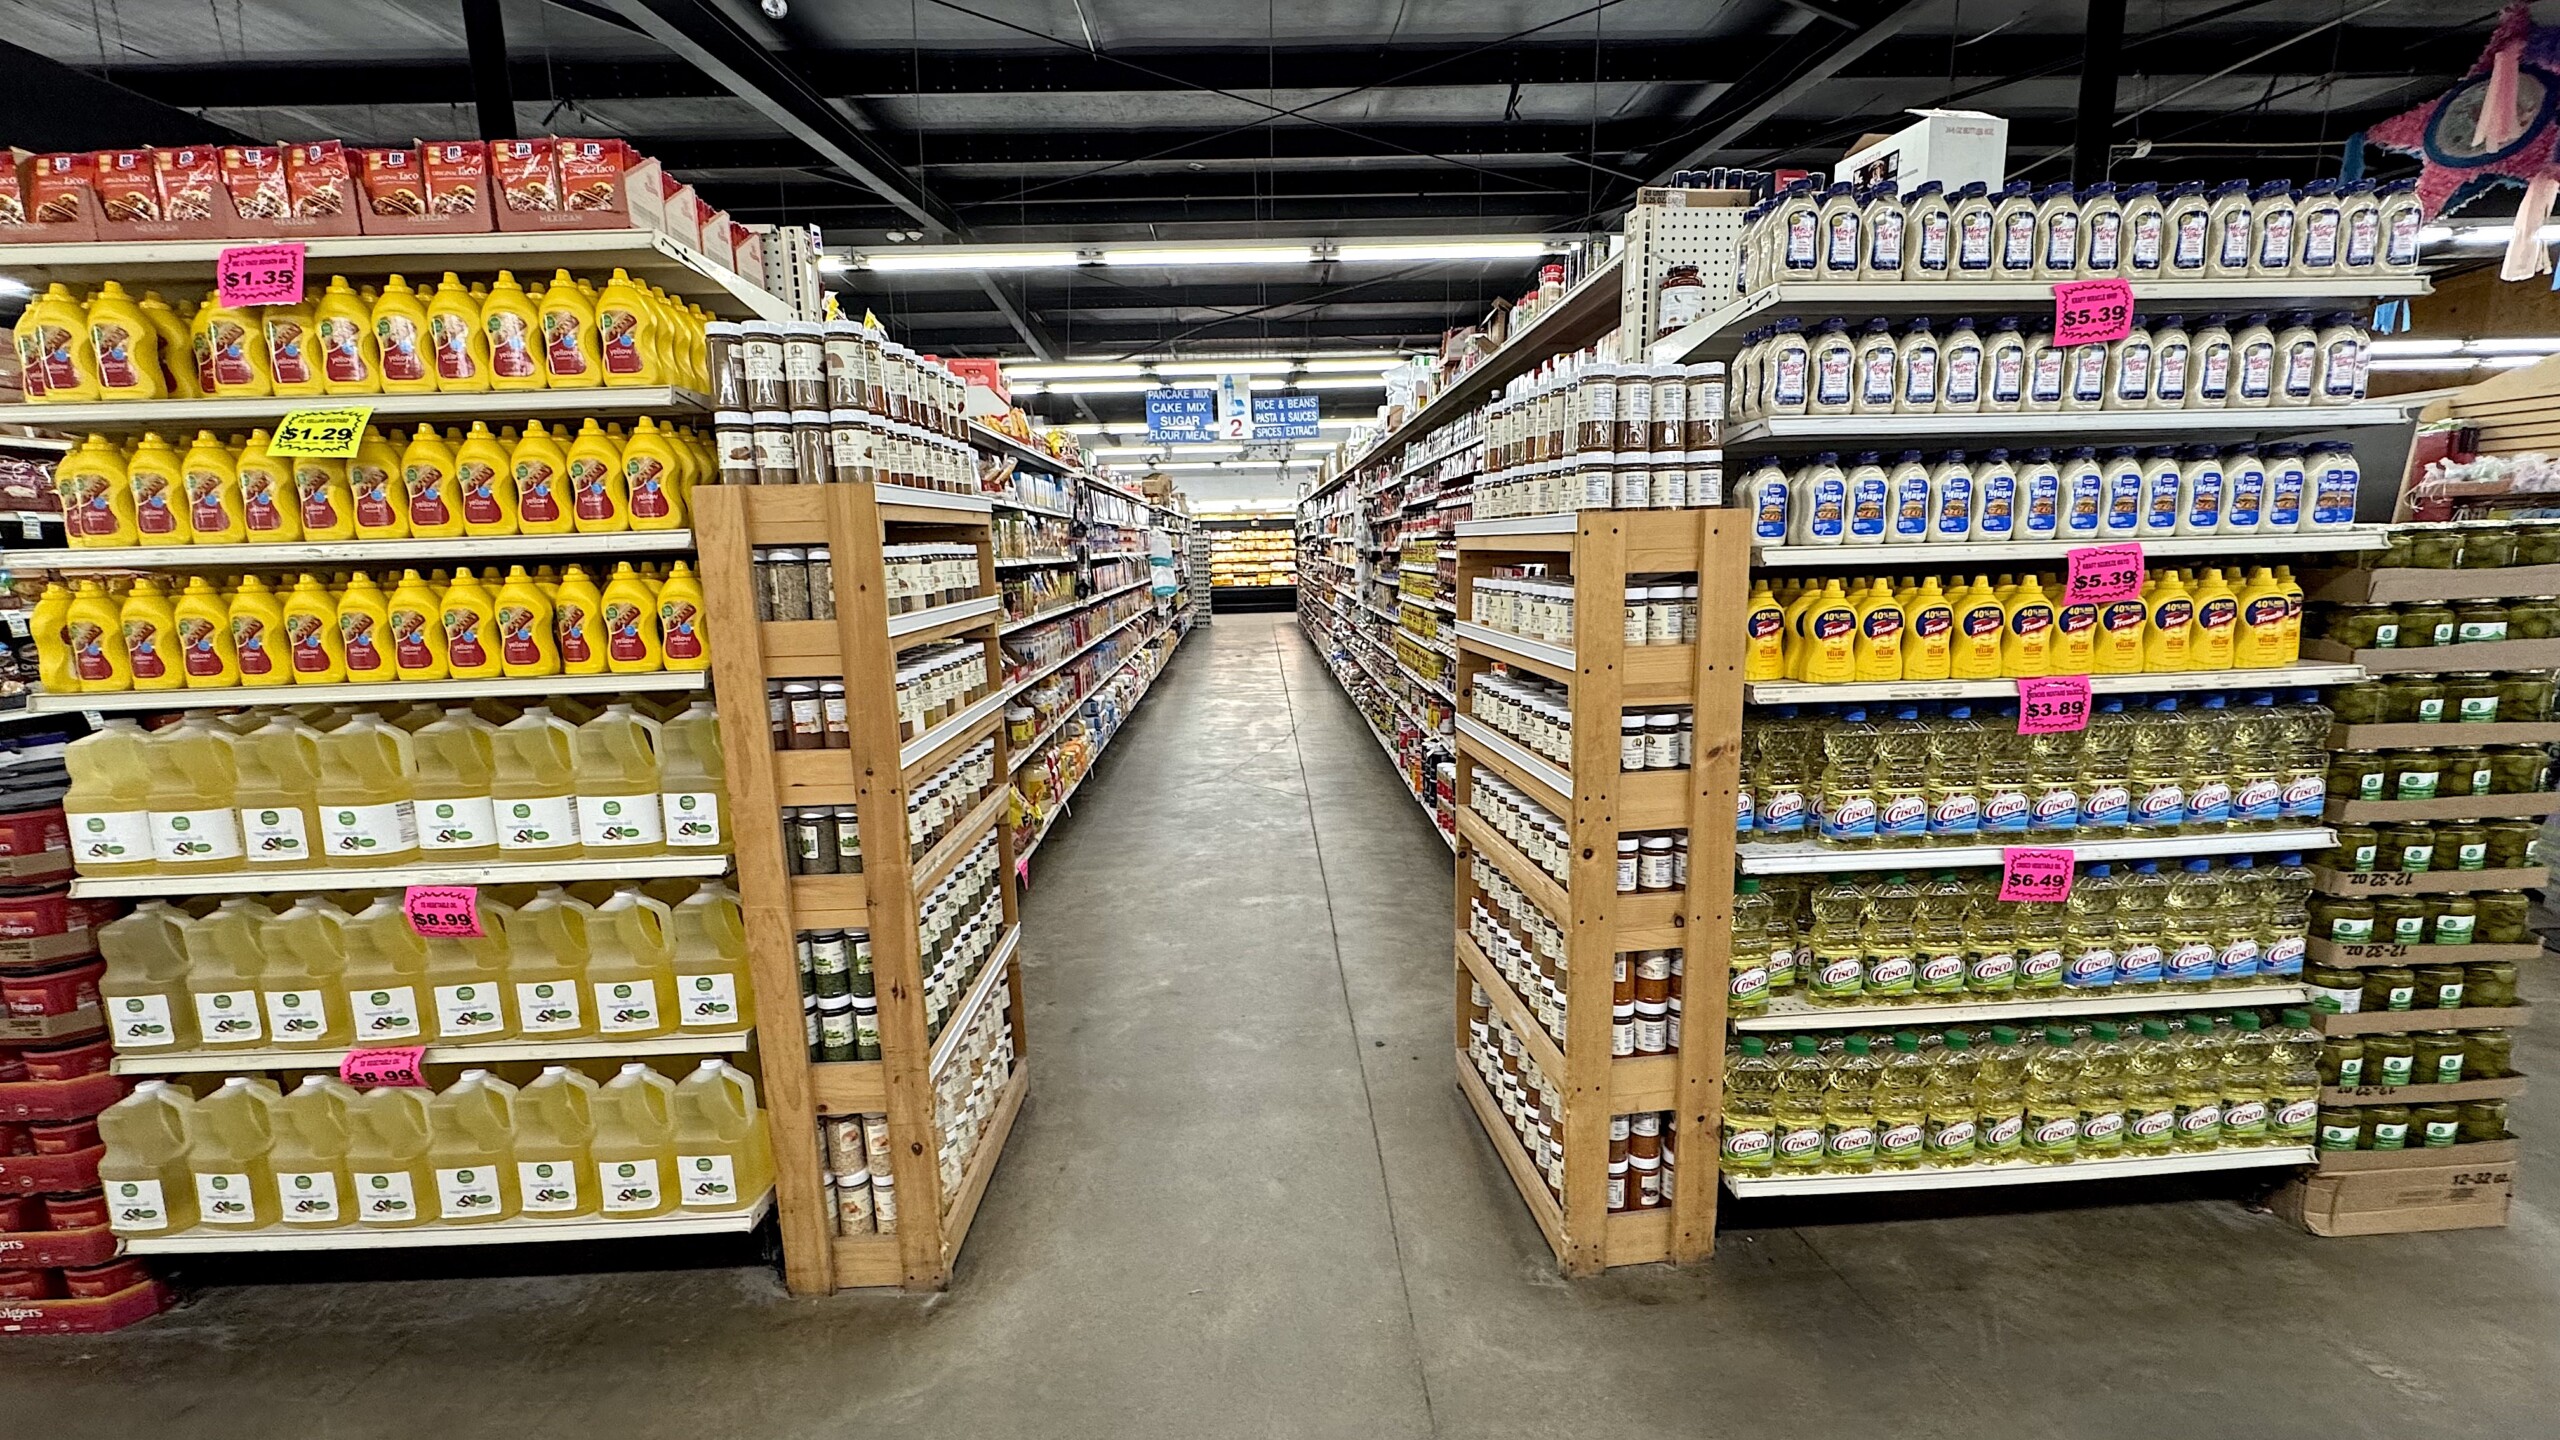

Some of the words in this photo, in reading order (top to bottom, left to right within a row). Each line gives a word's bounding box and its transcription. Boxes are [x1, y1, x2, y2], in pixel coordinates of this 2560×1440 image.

[458, 166, 478, 175] Taco
[595, 163, 615, 173] Taco
[398, 172, 419, 181] Taco
[226, 270, 293, 287] $1.35
[2064, 306, 2125, 326] $5.39
[553, 349, 575, 357] yellow
[610, 348, 633, 357] yellow
[1148, 391, 1189, 399] PANCAKE
[1193, 390, 1209, 399] MIX
[1152, 404, 1182, 413] CAKE
[1187, 403, 1206, 412] MIX
[1255, 400, 1274, 410] RICE
[1278, 400, 1284, 409] &
[1288, 399, 1316, 408] BEANS
[1160, 417, 1200, 426] SUGAR
[1256, 413, 1277, 423] PASTA
[1280, 413, 1286, 422] &
[1288, 412, 1317, 422] SAUCES
[1231, 419, 1242, 436] 2
[282, 428, 352, 440] $1.29
[2032, 488, 2056, 498] Mayo
[2076, 486, 2099, 496] Mayo
[2116, 486, 2139, 496] Mayo
[2154, 484, 2178, 494] Mayo
[2196, 484, 2221, 494] Mayo
[2237, 483, 2262, 493] Mayo
[2276, 482, 2301, 492] Mayo
[581, 495, 602, 504] yellow
[635, 493, 659, 503] yellow
[1762, 494, 1785, 504] Mayo
[1818, 492, 1842, 502] Mayo
[1857, 491, 1883, 502] Mayo
[1902, 490, 1926, 501] Mayo
[1945, 490, 1969, 500] Mayo
[1988, 489, 2012, 499] Mayo
[362, 502, 385, 511] yellow
[415, 501, 438, 510] yellow
[468, 500, 491, 508] yellow
[526, 497, 548, 506] yellow
[2075, 570, 2136, 589] $5.39
[2113, 604, 2130, 613] 40%
[2165, 603, 2182, 612] 40%
[2209, 602, 2226, 610] 40%
[2255, 600, 2272, 608] 40%
[1756, 612, 1771, 621] 40%
[1872, 611, 1889, 620] 40%
[1924, 611, 1940, 619] 40%
[1973, 609, 1990, 618] 40%
[2022, 608, 2038, 617] 40%
[2068, 606, 2085, 615] 40%
[1823, 613, 1840, 621] 40%
[508, 641, 530, 649] yellow
[615, 638, 636, 646] yellow
[671, 636, 692, 644] yellow
[401, 645, 422, 653] yellow
[454, 644, 475, 652] yellow
[2028, 701, 2084, 717] $3.89
[2240, 788, 2276, 807] Crisco
[2286, 784, 2320, 802] Crisco
[2091, 794, 2124, 814] Crisco
[2145, 793, 2178, 812] Crisco
[2194, 790, 2226, 809] Crisco
[1768, 798, 1800, 820] Crisco
[1887, 803, 1922, 823] Crisco
[1939, 801, 1974, 821] Crisco
[1991, 799, 2025, 818] Crisco
[2039, 798, 2072, 816] Crisco
[1839, 805, 1872, 824] Crisco
[2010, 874, 2065, 887] $6.49
[2370, 873, 2412, 886] 12-32
[413, 913, 471, 926] $8.99
[2221, 946, 2256, 966] Crisco
[2269, 944, 2303, 963] Crisco
[2366, 945, 2407, 957] 12-32
[1769, 956, 1791, 972] risco
[2028, 956, 2059, 975] Crisco
[2079, 956, 2110, 973] Crisco
[2125, 951, 2158, 970] Crisco
[2177, 950, 2211, 969] Crisco
[1826, 965, 1858, 984] Crisco
[1876, 963, 1908, 983] Crisco
[1927, 961, 1959, 981] Crisco
[1978, 960, 2010, 978] Crisco
[1735, 975, 1765, 994] Crisco
[349, 1070, 414, 1083] $8.99
[2230, 1108, 2263, 1127] Crisco
[2280, 1105, 2313, 1124] Crisco
[2137, 1117, 2171, 1136] Crisco
[2186, 1111, 2217, 1132] Crisco
[1991, 1121, 2021, 1144] Crisco
[2039, 1125, 2074, 1143] Crisco
[2087, 1119, 2120, 1139] Crisco
[1885, 1132, 1919, 1149] Crisco
[1940, 1126, 1973, 1147] Crisco
[1731, 1137, 1766, 1153] Crisco
[1784, 1136, 1817, 1152] Crisco
[1836, 1135, 1869, 1152] Crisco
